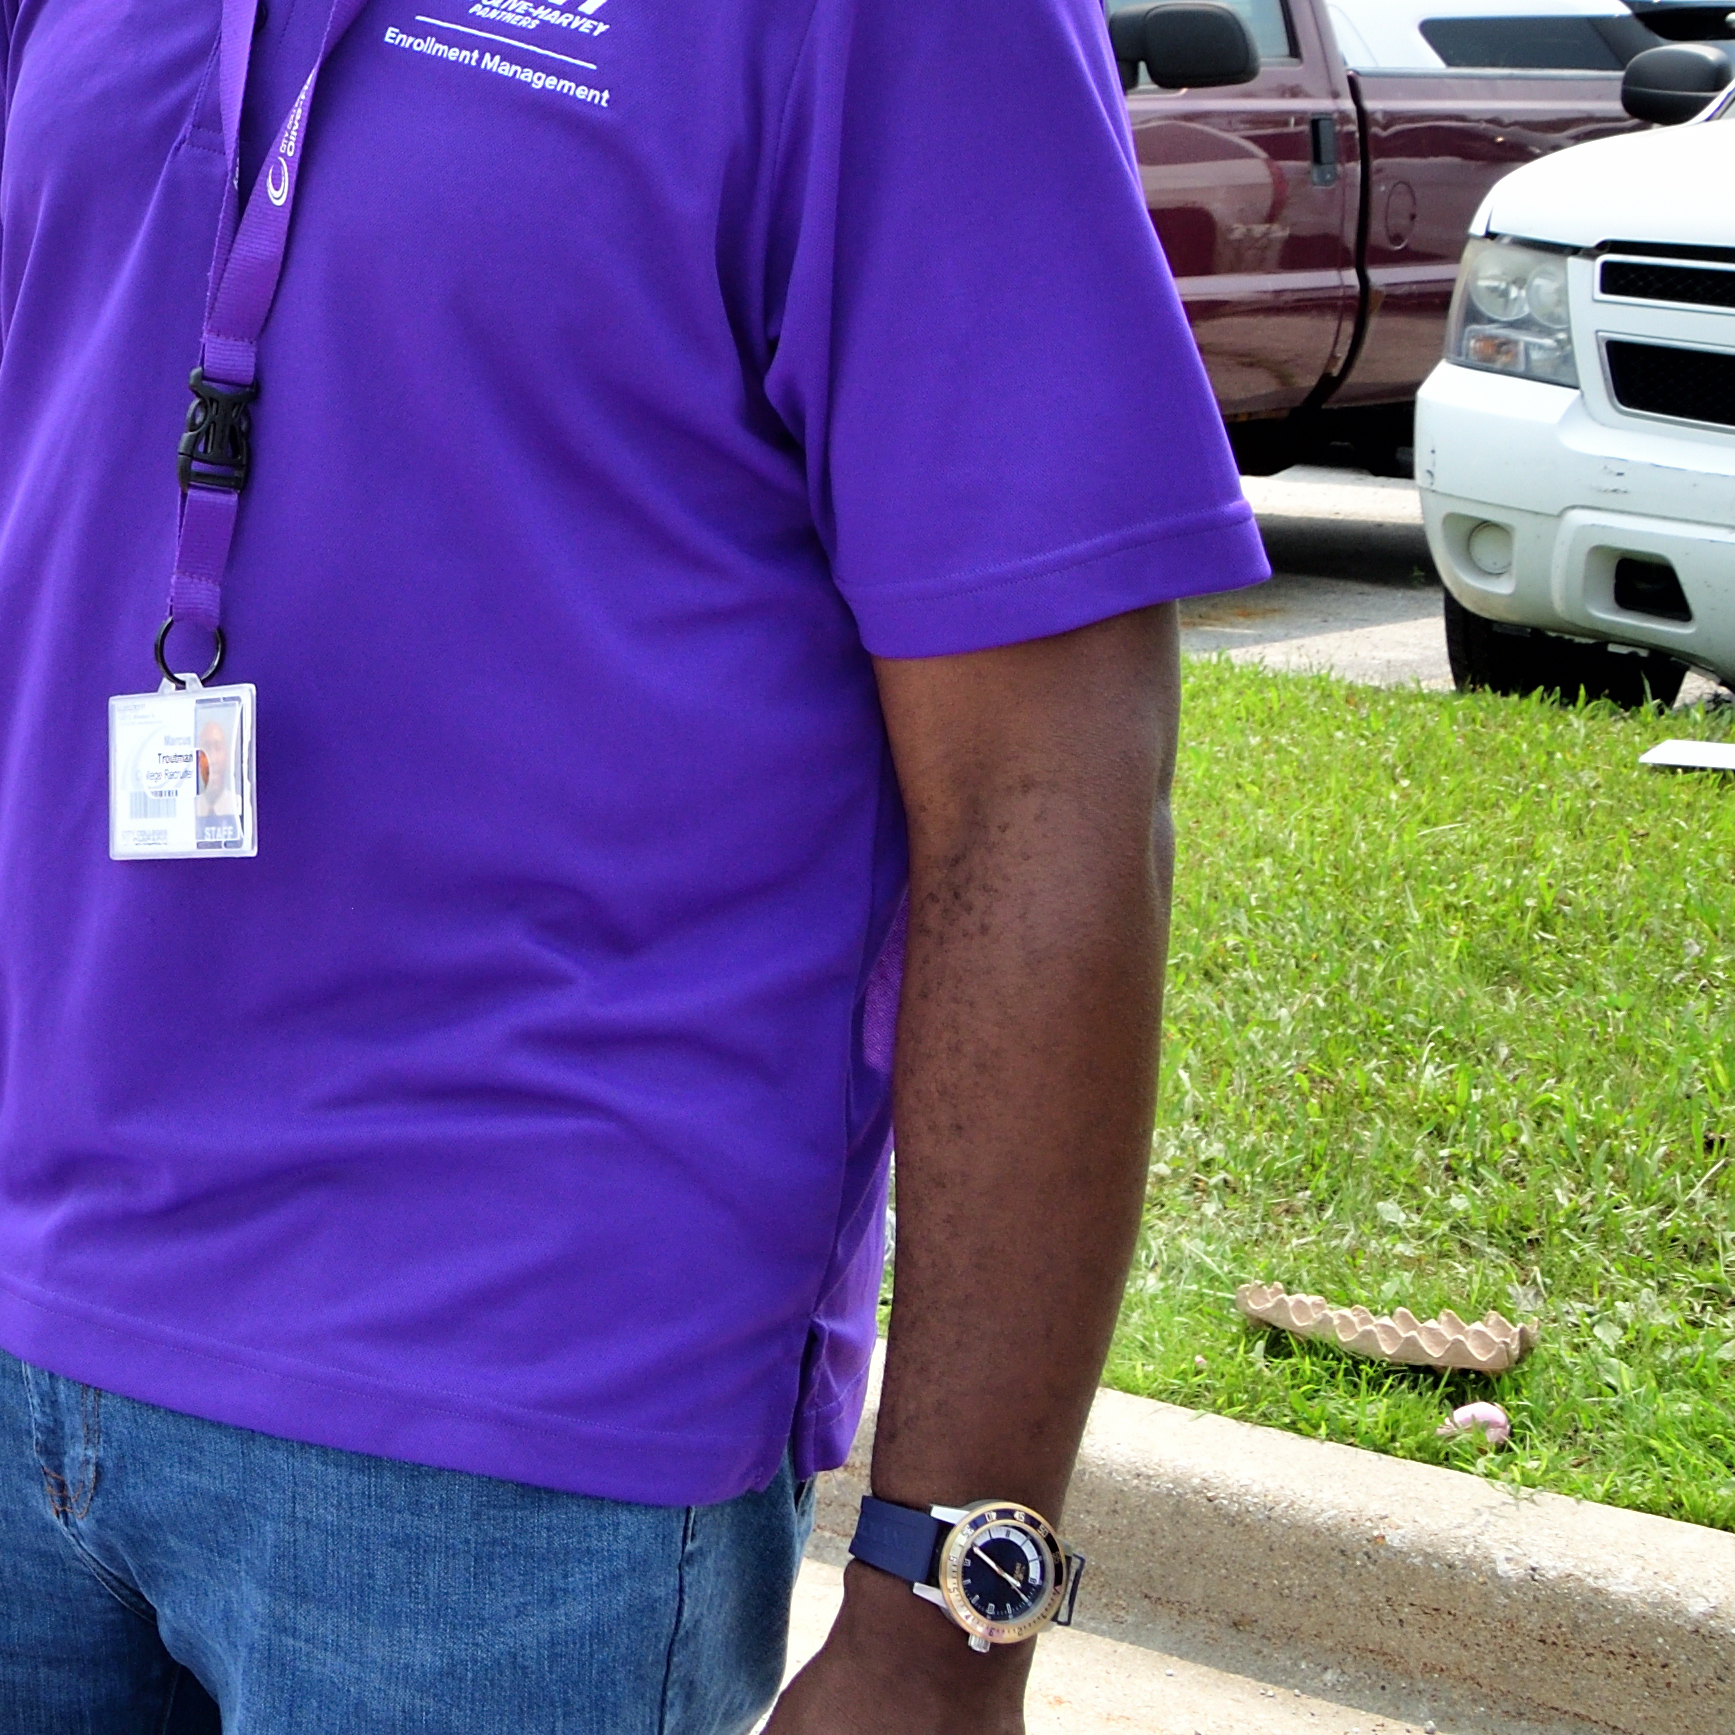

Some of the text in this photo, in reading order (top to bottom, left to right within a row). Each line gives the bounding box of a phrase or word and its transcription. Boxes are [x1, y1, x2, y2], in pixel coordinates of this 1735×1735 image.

[468, 3, 541, 30] PANTHERS
[383, 26, 611, 108] Enrollment Management
